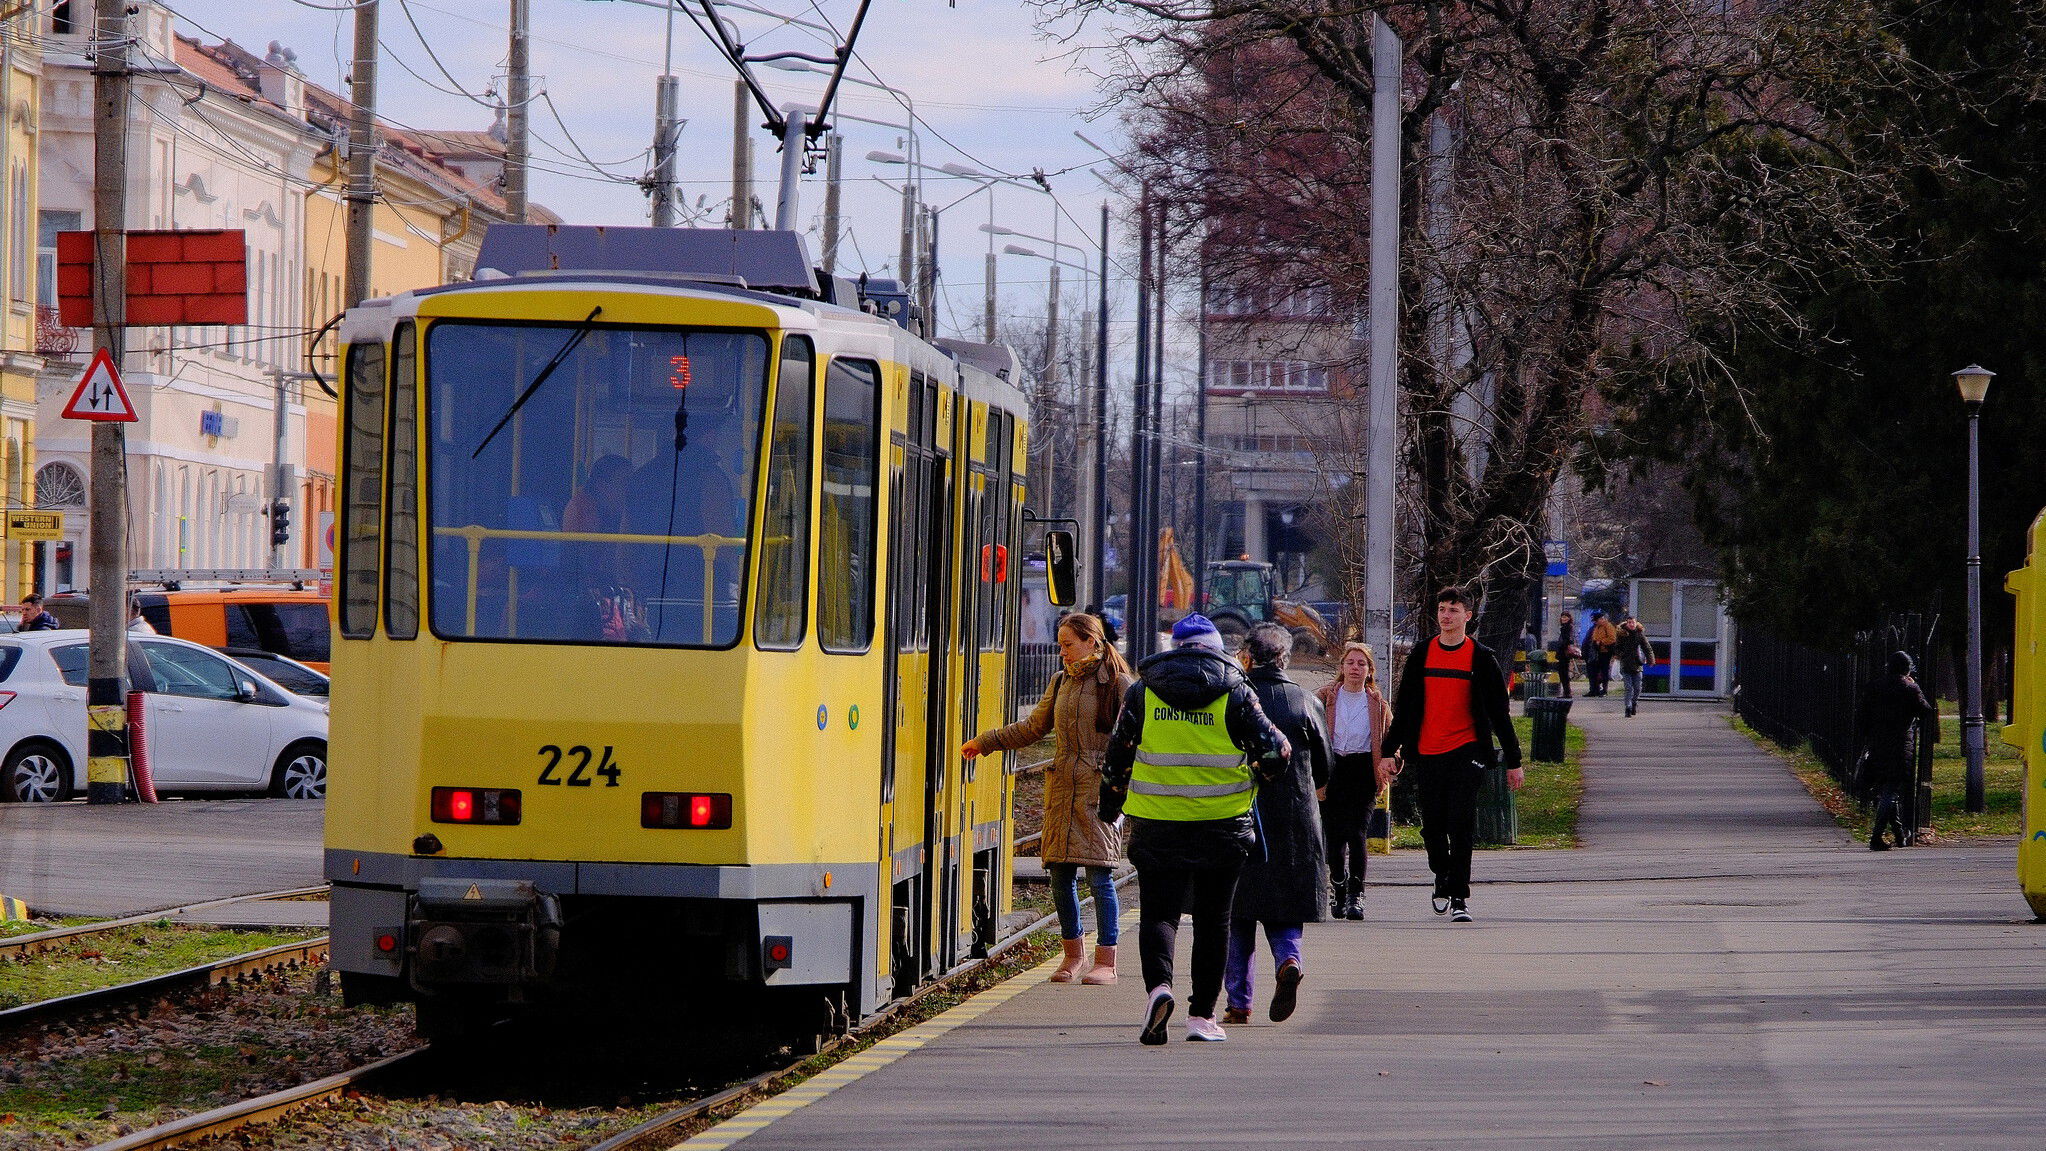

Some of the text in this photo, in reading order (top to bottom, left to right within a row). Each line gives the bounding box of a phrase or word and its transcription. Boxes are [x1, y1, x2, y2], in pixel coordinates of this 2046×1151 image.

[670, 356, 691, 389] 3
[1154, 707, 1214, 725] CONSTATATOR
[538, 744, 621, 787] 224
